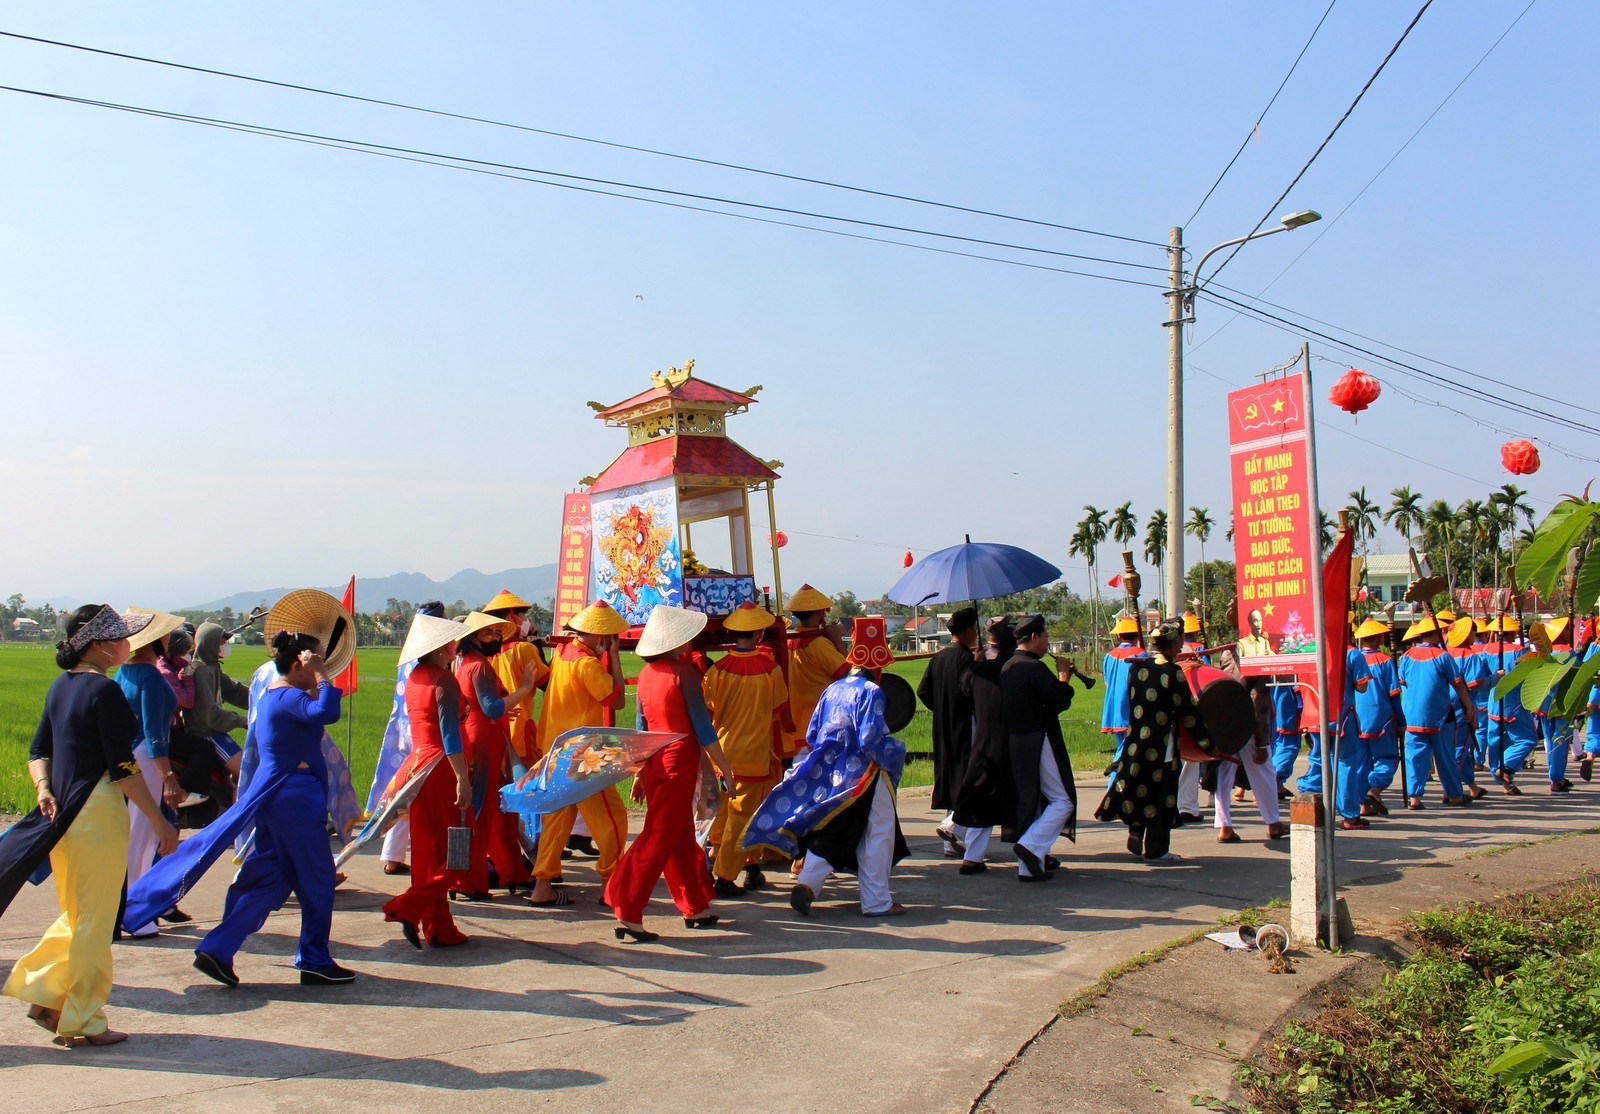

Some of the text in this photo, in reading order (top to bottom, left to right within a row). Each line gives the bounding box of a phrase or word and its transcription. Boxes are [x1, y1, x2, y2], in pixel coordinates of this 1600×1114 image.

[1244, 452, 1292, 476] ĐẨY MẠNH
[1250, 470, 1288, 498] HỌC TẬP
[1241, 494, 1300, 518] VÀ LÀM THEO
[1248, 514, 1294, 537] TƯ TƯỞNG,
[1251, 536, 1294, 560] ĐẠO ĐỨC,
[1244, 556, 1302, 579] PHONG CÁCH
[1243, 578, 1306, 600] HỒ CHÍ MINH !
